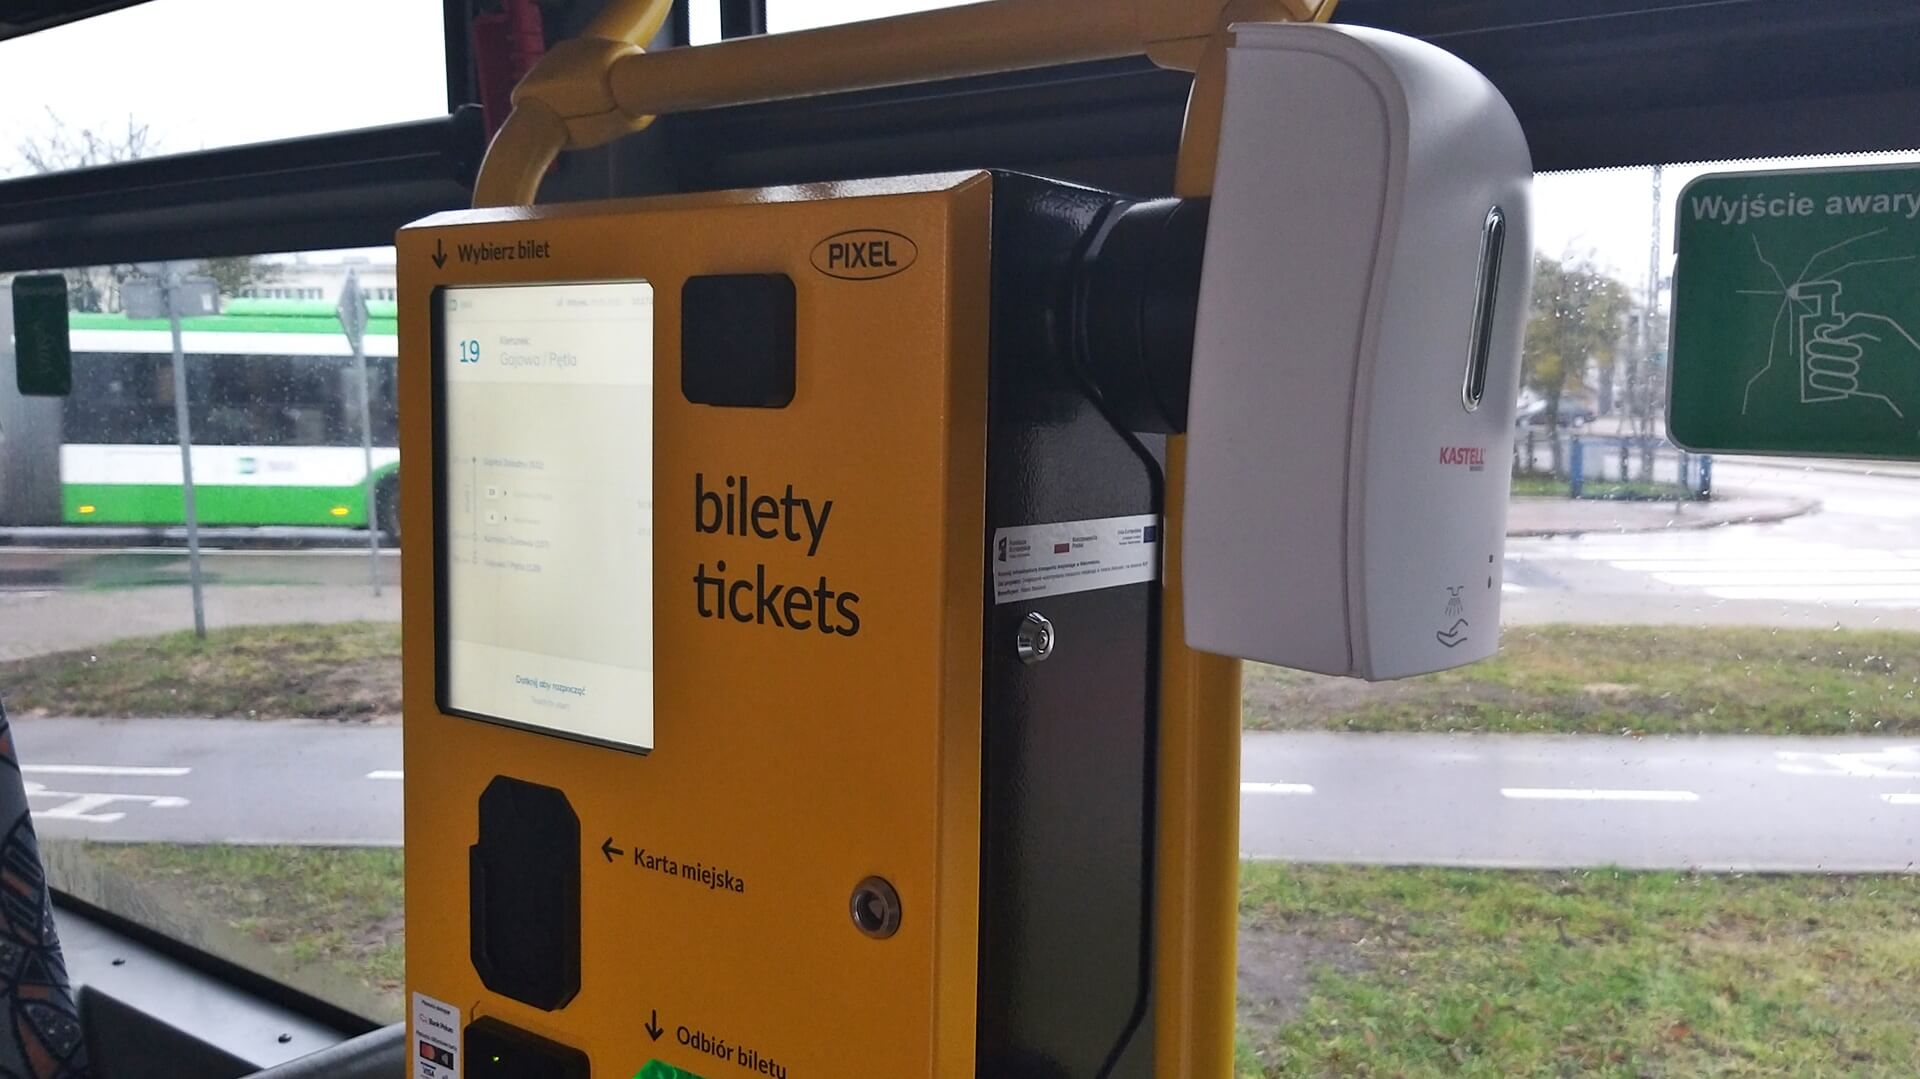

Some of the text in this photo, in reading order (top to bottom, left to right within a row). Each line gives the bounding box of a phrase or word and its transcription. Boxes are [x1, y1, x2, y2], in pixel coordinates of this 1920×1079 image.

[1692, 192, 1814, 226] Wyjście
[458, 240, 551, 264] Wybierz bilet
[828, 241, 897, 269] PIXEL
[459, 340, 480, 363] 19
[500, 352, 541, 371] Gajowa
[549, 352, 577, 370] Pętla
[694, 472, 833, 557] bilety
[693, 559, 861, 638] tickets
[633, 846, 745, 894] Karta miejska
[676, 1026, 787, 1079] Odbiór biletu
